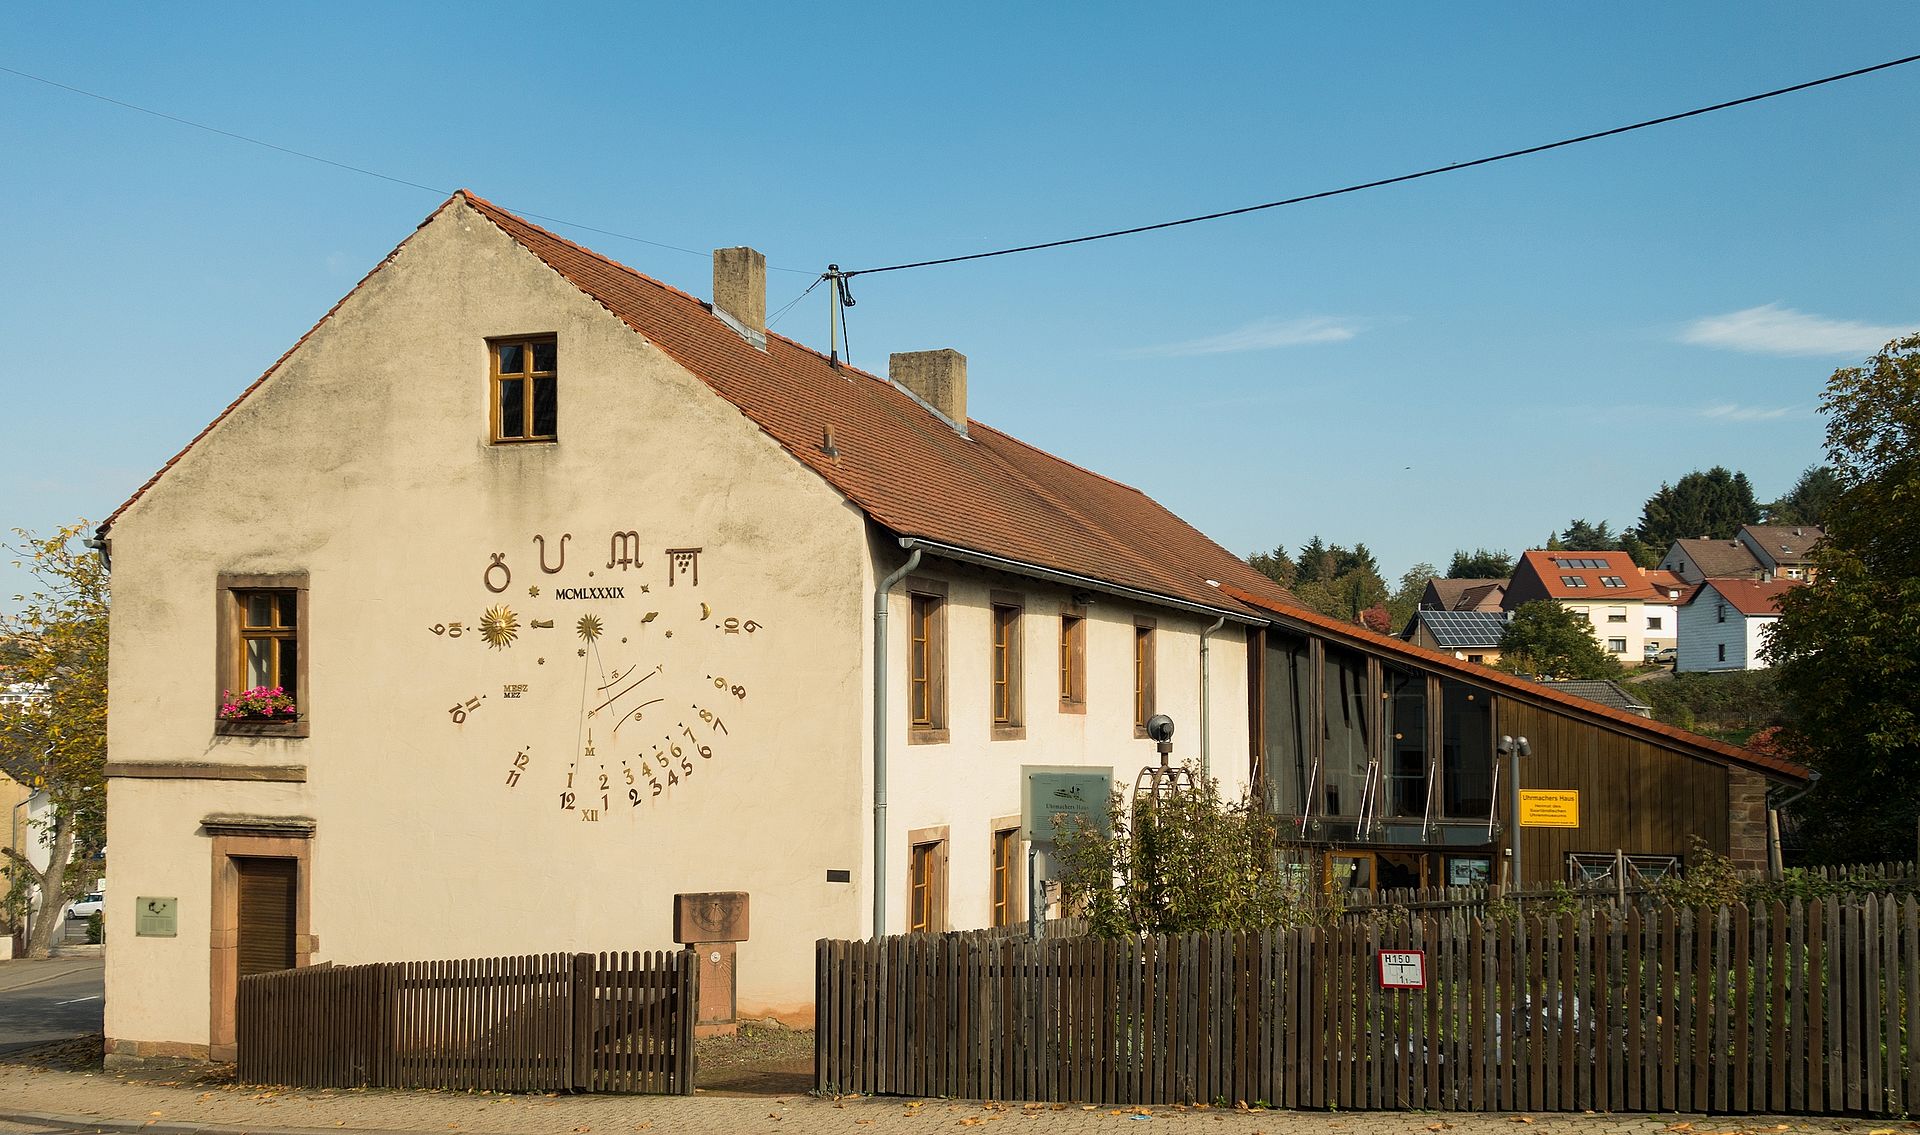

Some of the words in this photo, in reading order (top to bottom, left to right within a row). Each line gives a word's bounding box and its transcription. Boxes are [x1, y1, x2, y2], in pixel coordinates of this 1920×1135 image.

[556, 587, 625, 600] MCMLXXXIX
[503, 684, 528, 693] MESZ
[731, 685, 746, 699] 8
[448, 703, 467, 724] 10
[699, 709, 713, 723] 8
[712, 717, 728, 735] 7
[682, 727, 697, 744] 7
[585, 747, 595, 757] M
[670, 742, 682, 758] 6
[697, 743, 712, 759] 6
[513, 751, 530, 771] 12
[655, 751, 669, 768] 5
[681, 756, 693, 776] 5
[623, 768, 634, 785] 3
[642, 761, 652, 777] 4
[668, 769, 679, 786] 4
[505, 770, 521, 787] 11
[567, 772, 573, 788] 1
[598, 774, 610, 790] 2
[649, 777, 662, 796] 3
[560, 792, 576, 810] 12
[601, 794, 608, 811] 1
[628, 788, 642, 807] 2
[581, 809, 599, 821] XII
